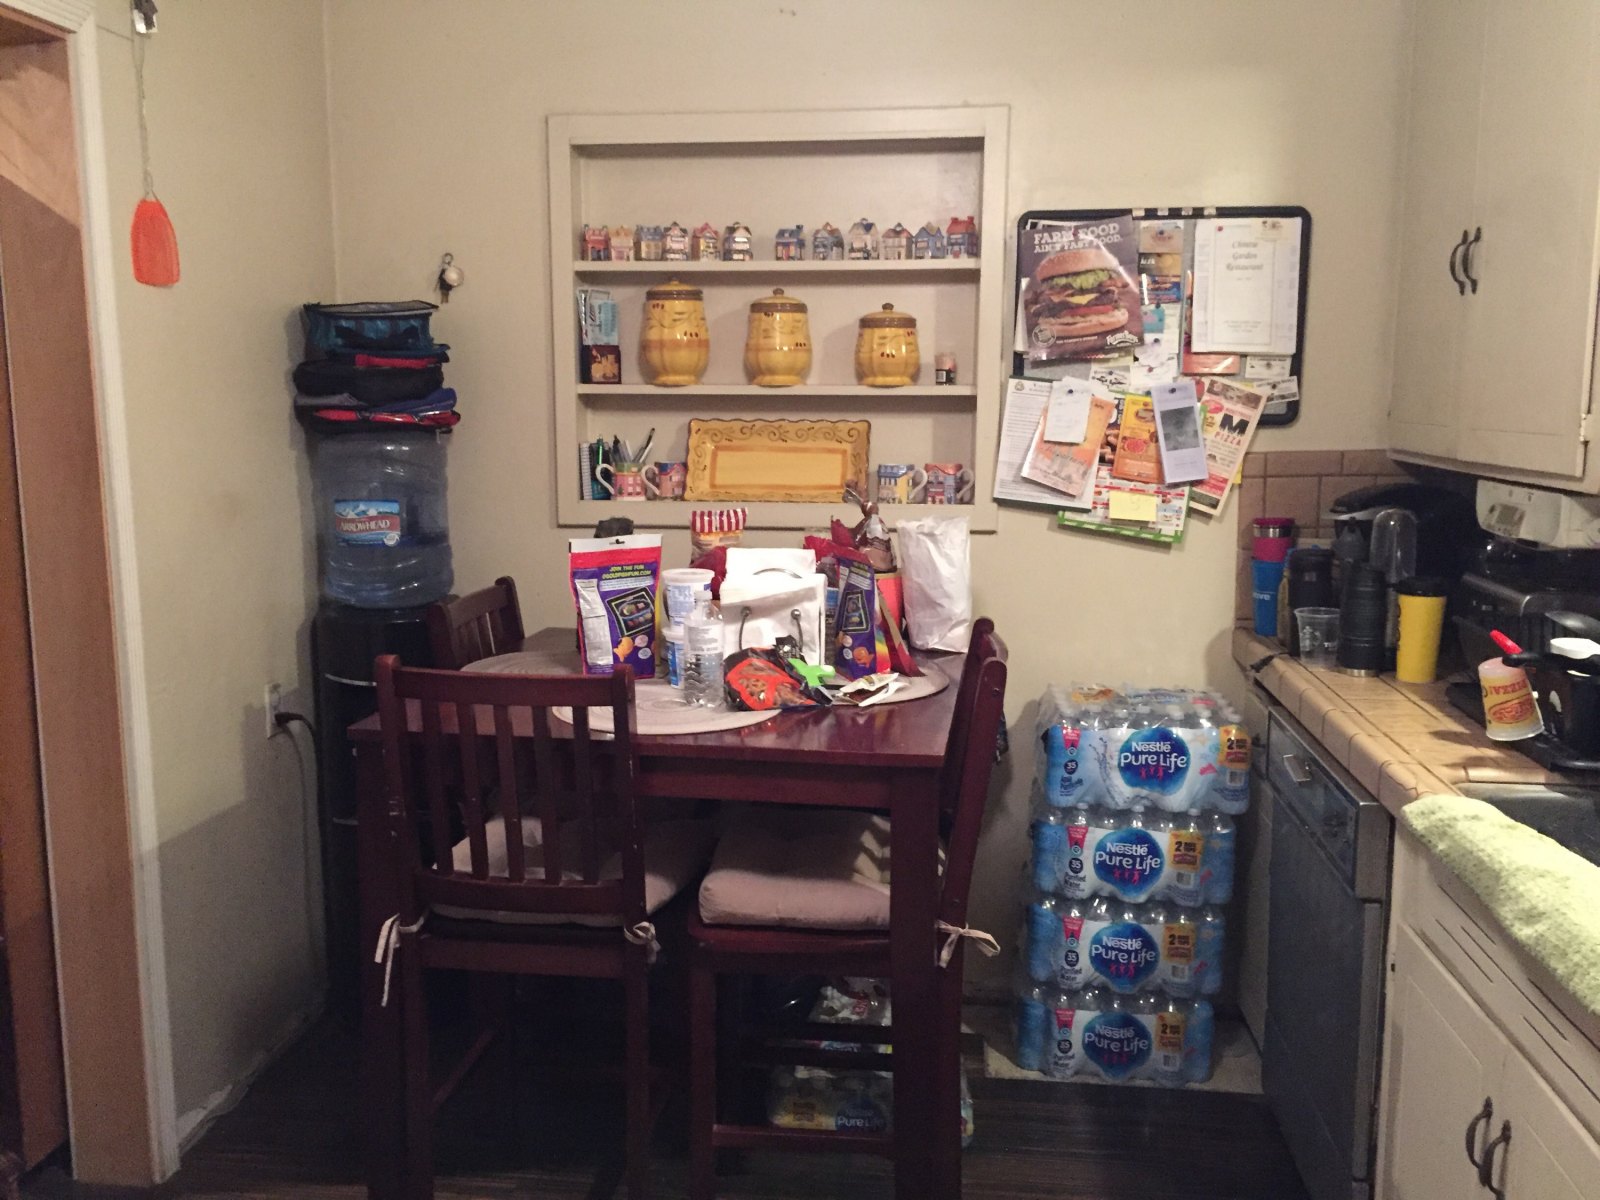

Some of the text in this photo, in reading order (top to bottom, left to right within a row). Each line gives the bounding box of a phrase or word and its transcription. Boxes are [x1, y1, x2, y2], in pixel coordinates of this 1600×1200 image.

[1034, 222, 1119, 244] FARM FOOD
[1064, 240, 1088, 250] FAST
[1219, 412, 1250, 436] M
[1214, 431, 1242, 446] PIZZA
[340, 519, 391, 531] ARROWHEAD
[1120, 752, 1188, 773] Pure Life
[1095, 852, 1133, 869] Pure
[1135, 855, 1161, 875] Life
[1091, 944, 1128, 963] Pure
[1130, 948, 1156, 967] Life
[1084, 1033, 1121, 1052] Pure
[1123, 1037, 1149, 1053] Life
[838, 1115, 864, 1127] Pure
